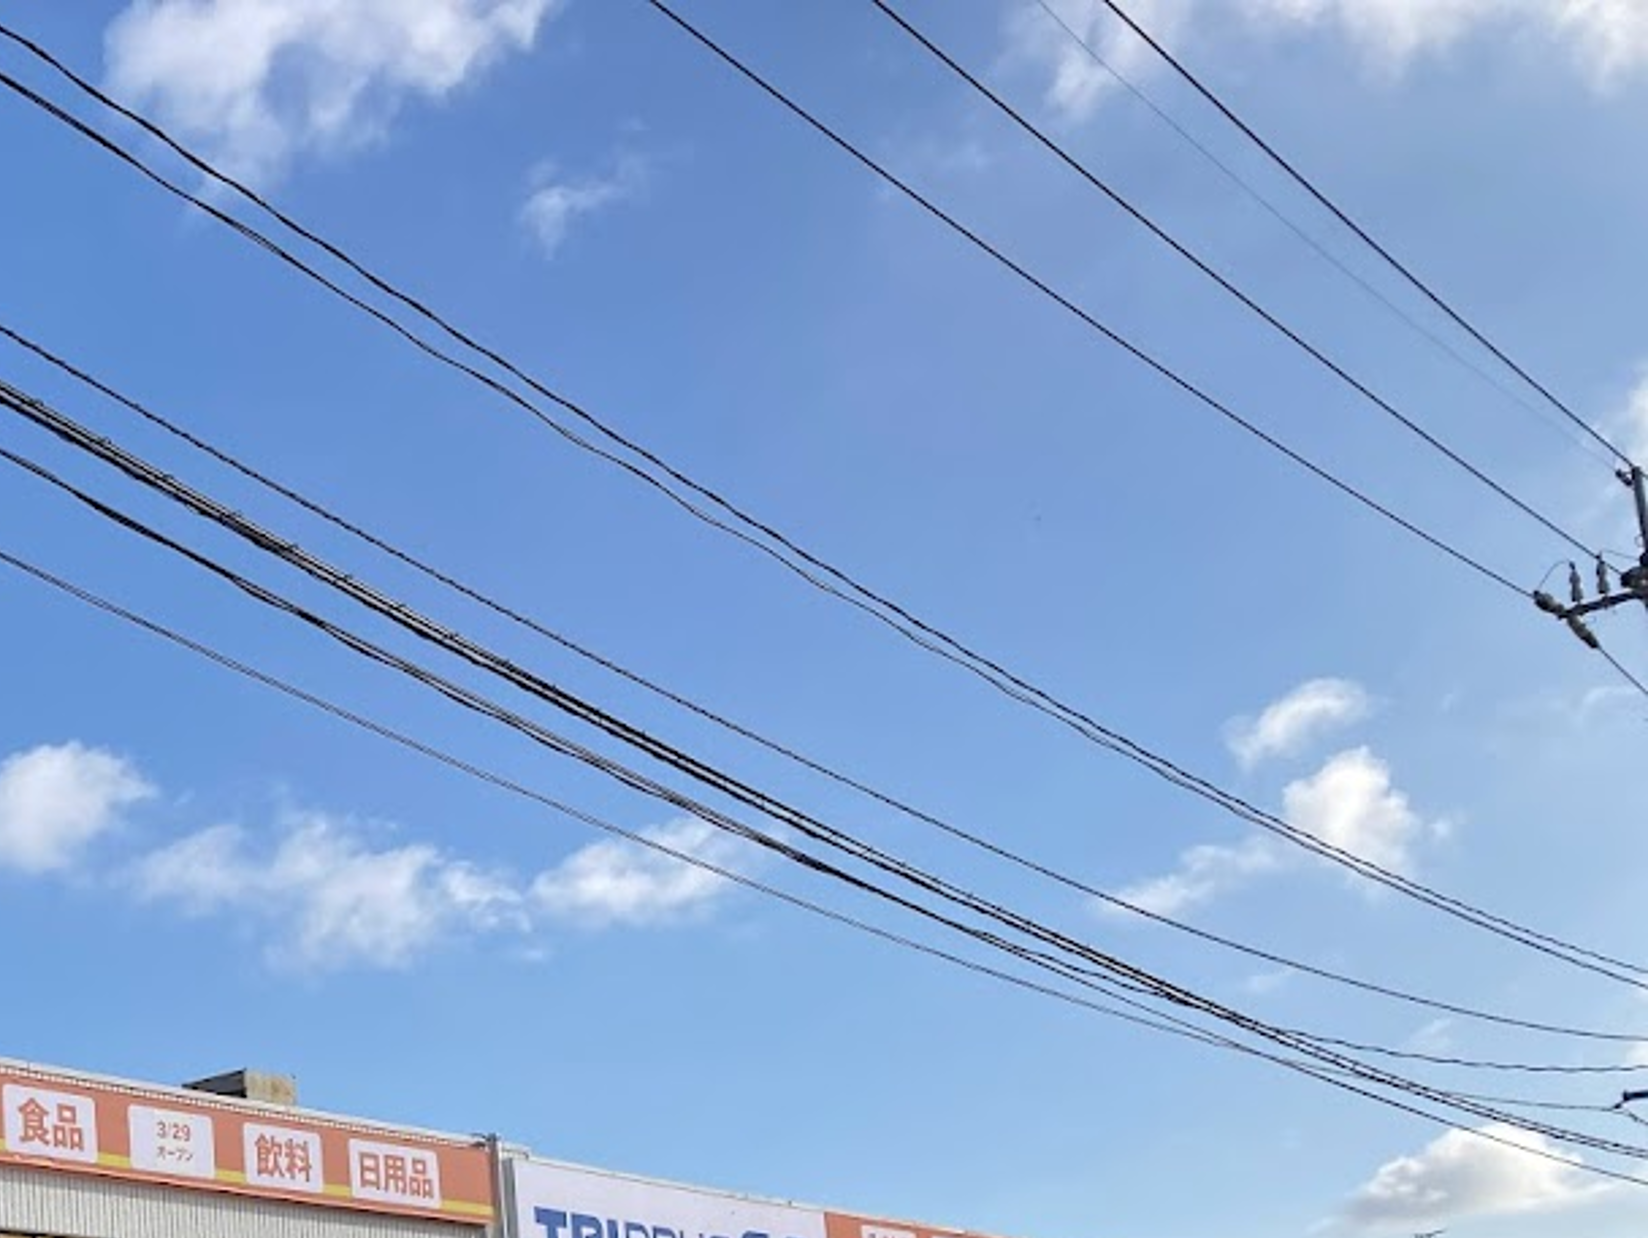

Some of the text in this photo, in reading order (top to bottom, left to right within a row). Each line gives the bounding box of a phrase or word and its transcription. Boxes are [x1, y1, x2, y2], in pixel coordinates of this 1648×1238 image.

[17, 1097, 85, 1152] 食品
[255, 1133, 312, 1182] 飲料
[359, 1152, 434, 1200] 日用品
